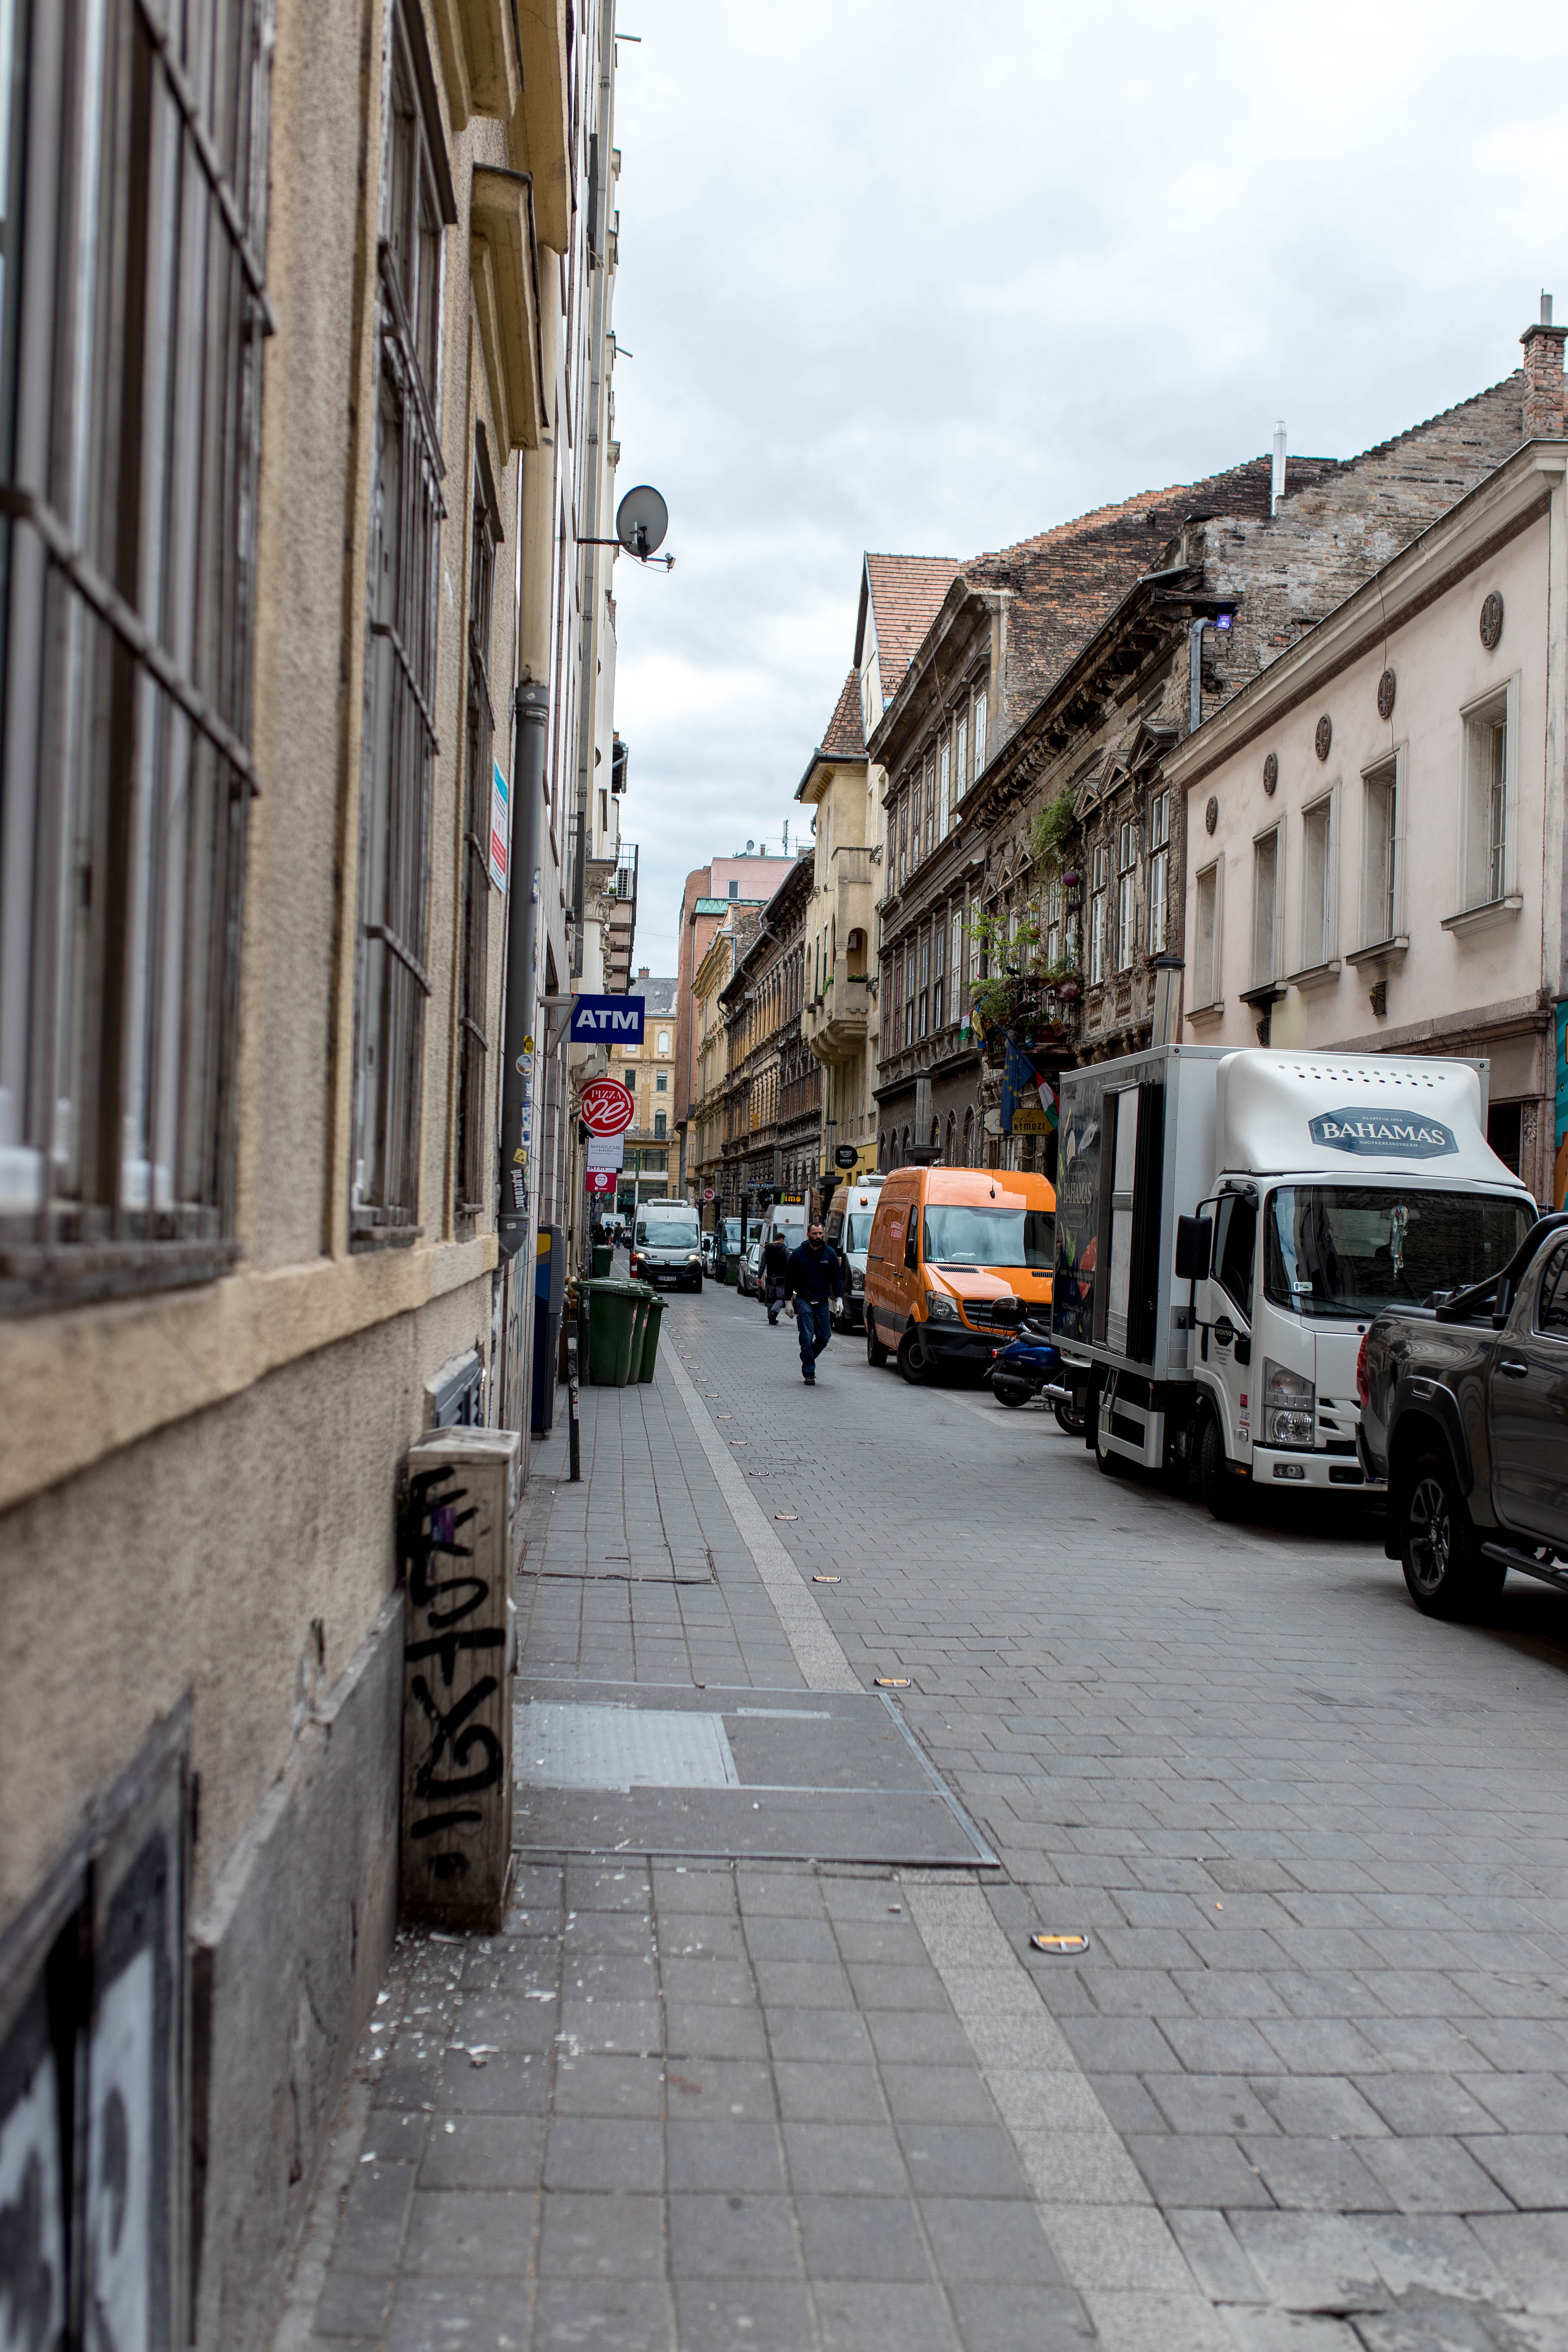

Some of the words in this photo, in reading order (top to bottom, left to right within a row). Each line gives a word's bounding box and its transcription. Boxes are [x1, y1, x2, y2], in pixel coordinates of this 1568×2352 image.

[576, 1010, 638, 1029] ATM
[592, 1090, 622, 1099] PIZZA
[1321, 1122, 1445, 1145] BAHAMAS
[1063, 1182, 1092, 1204] BAHAMAS
